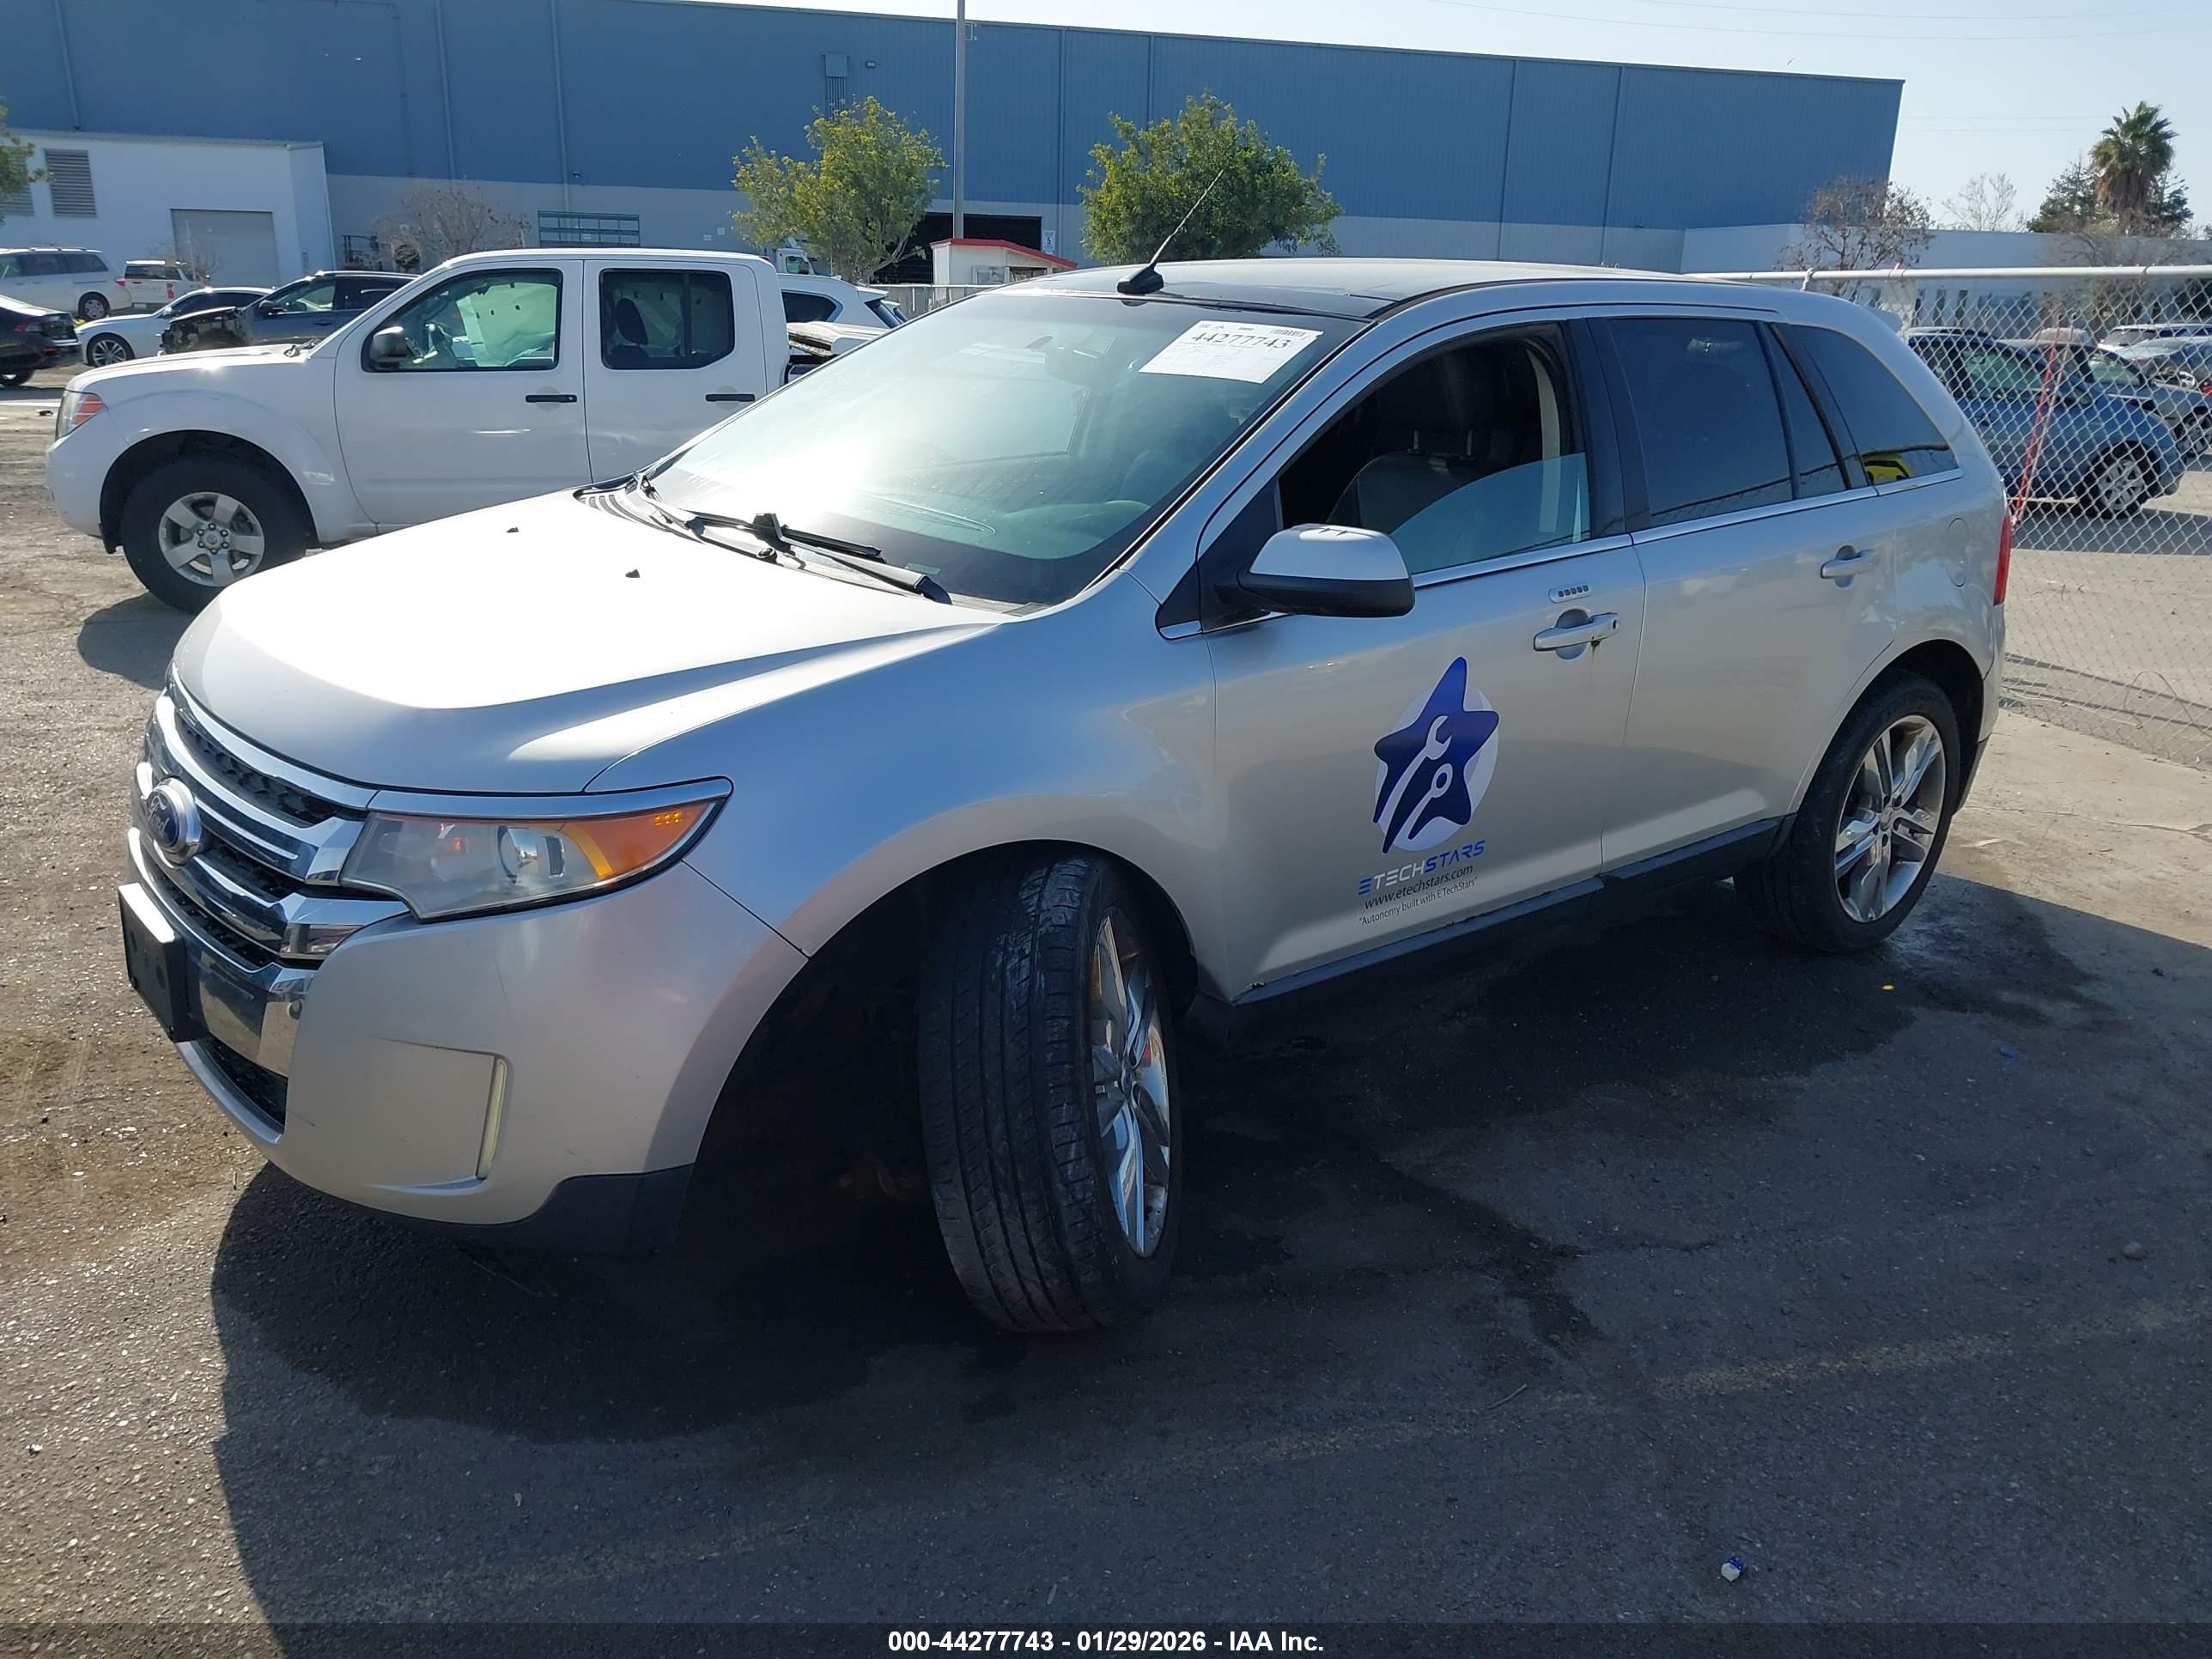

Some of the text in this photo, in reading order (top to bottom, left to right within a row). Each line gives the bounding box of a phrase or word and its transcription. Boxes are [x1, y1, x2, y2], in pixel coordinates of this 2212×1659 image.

[1190, 332, 1291, 349] 44277743
[1364, 865, 1474, 910] www.etechstars.com
[1402, 899, 1419, 912] built
[1419, 893, 1436, 907] with
[1437, 890, 1443, 900] E
